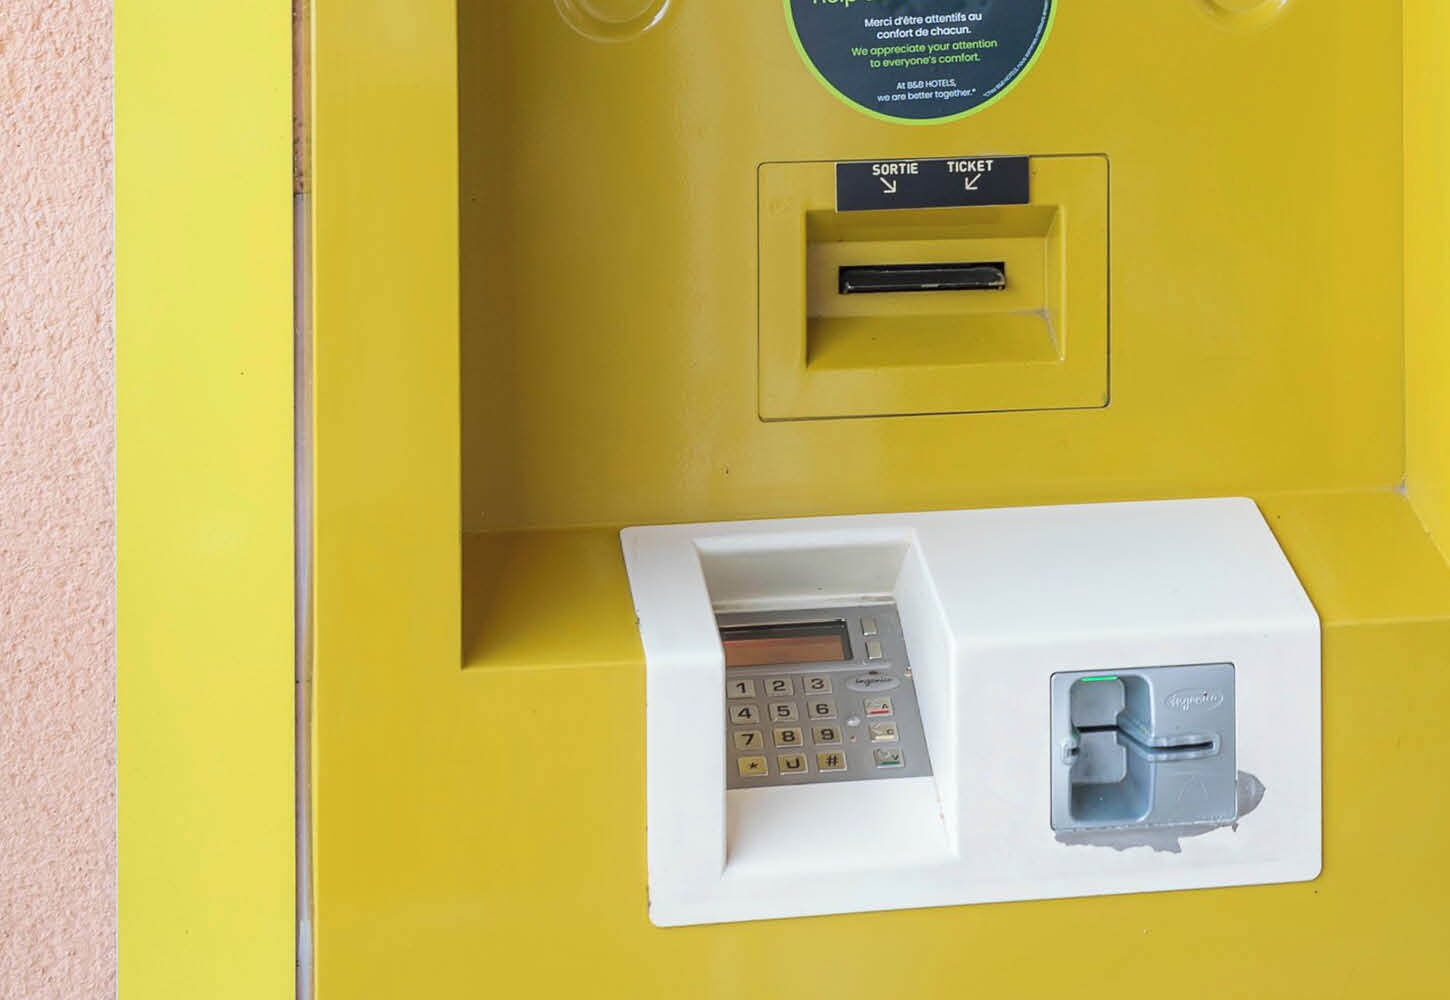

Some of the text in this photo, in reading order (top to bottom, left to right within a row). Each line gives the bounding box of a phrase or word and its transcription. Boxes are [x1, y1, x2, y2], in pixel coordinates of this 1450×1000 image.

[864, 12, 982, 28] Merci d'être attentifs au
[876, 26, 972, 40] confort de chacun.
[851, 39, 998, 57] We appreciate your attention
[869, 53, 981, 68] to everyone's comfort.
[896, 79, 957, 90] At B&B HOTELS,
[891, 93, 906, 101] are
[907, 90, 934, 100] better
[872, 159, 994, 176] SORTIE TICKET
[736, 678, 824, 694] 1 2 3
[738, 703, 829, 719] 4 5 6
[741, 729, 834, 745] 7 8 9
[826, 755, 838, 766] #
